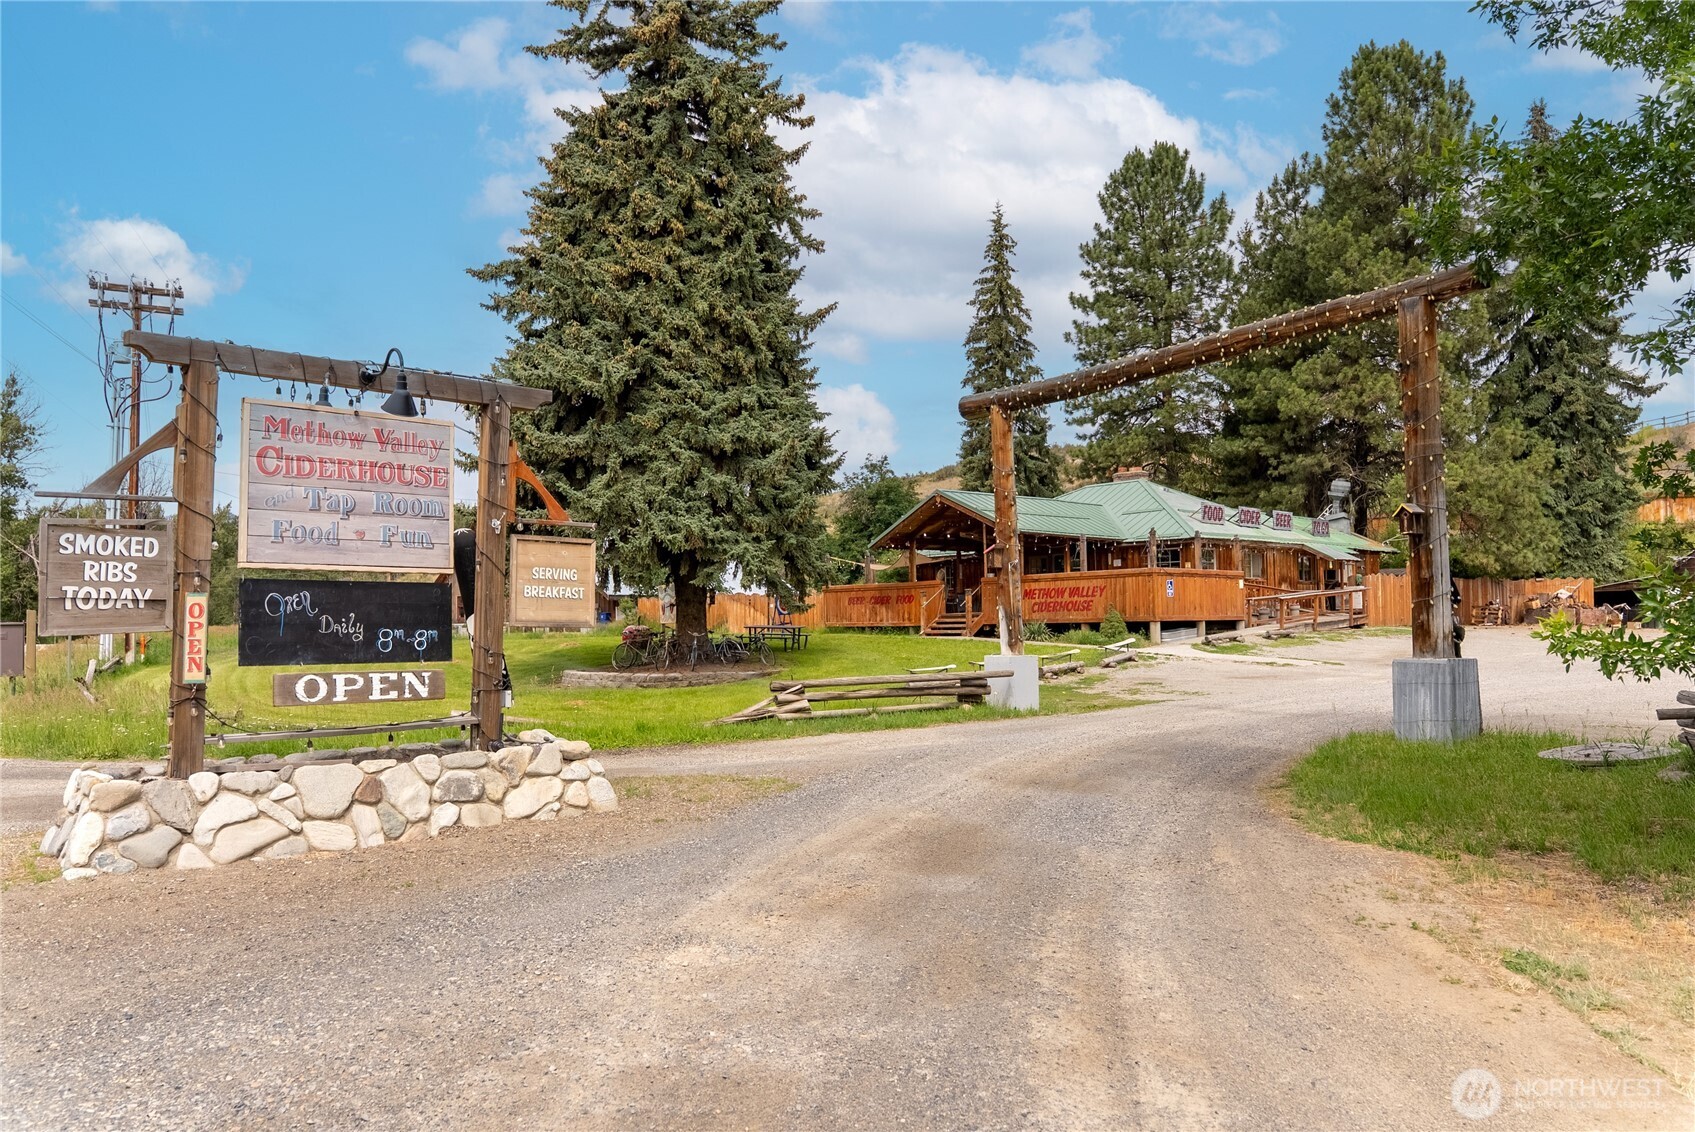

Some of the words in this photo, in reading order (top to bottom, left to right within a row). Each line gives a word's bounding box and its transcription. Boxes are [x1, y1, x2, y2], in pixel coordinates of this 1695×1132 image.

[262, 414, 367, 449] Methow
[371, 427, 444, 462] Valley
[255, 445, 449, 489] CIDERHOUSE
[264, 483, 297, 508] and
[302, 486, 356, 520] Tap
[372, 492, 446, 519] Room
[1202, 505, 1224, 522] FOOD
[1240, 509, 1260, 526] CIDER
[1275, 512, 1292, 528] BEER
[59, 532, 160, 558] SMOKED
[271, 519, 340, 546] Food
[379, 524, 434, 549] Fun
[83, 560, 138, 583] RIBS
[532, 567, 578, 581] SERVING
[61, 585, 153, 610] TODAY
[524, 585, 585, 599] BREAKFAST
[1023, 586, 1066, 600] METHOW
[1068, 583, 1107, 598] VALLEY
[1031, 600, 1093, 613] CIDERHOUSE
[187, 602, 205, 673] OPEN
[294, 672, 432, 703] OPEN
